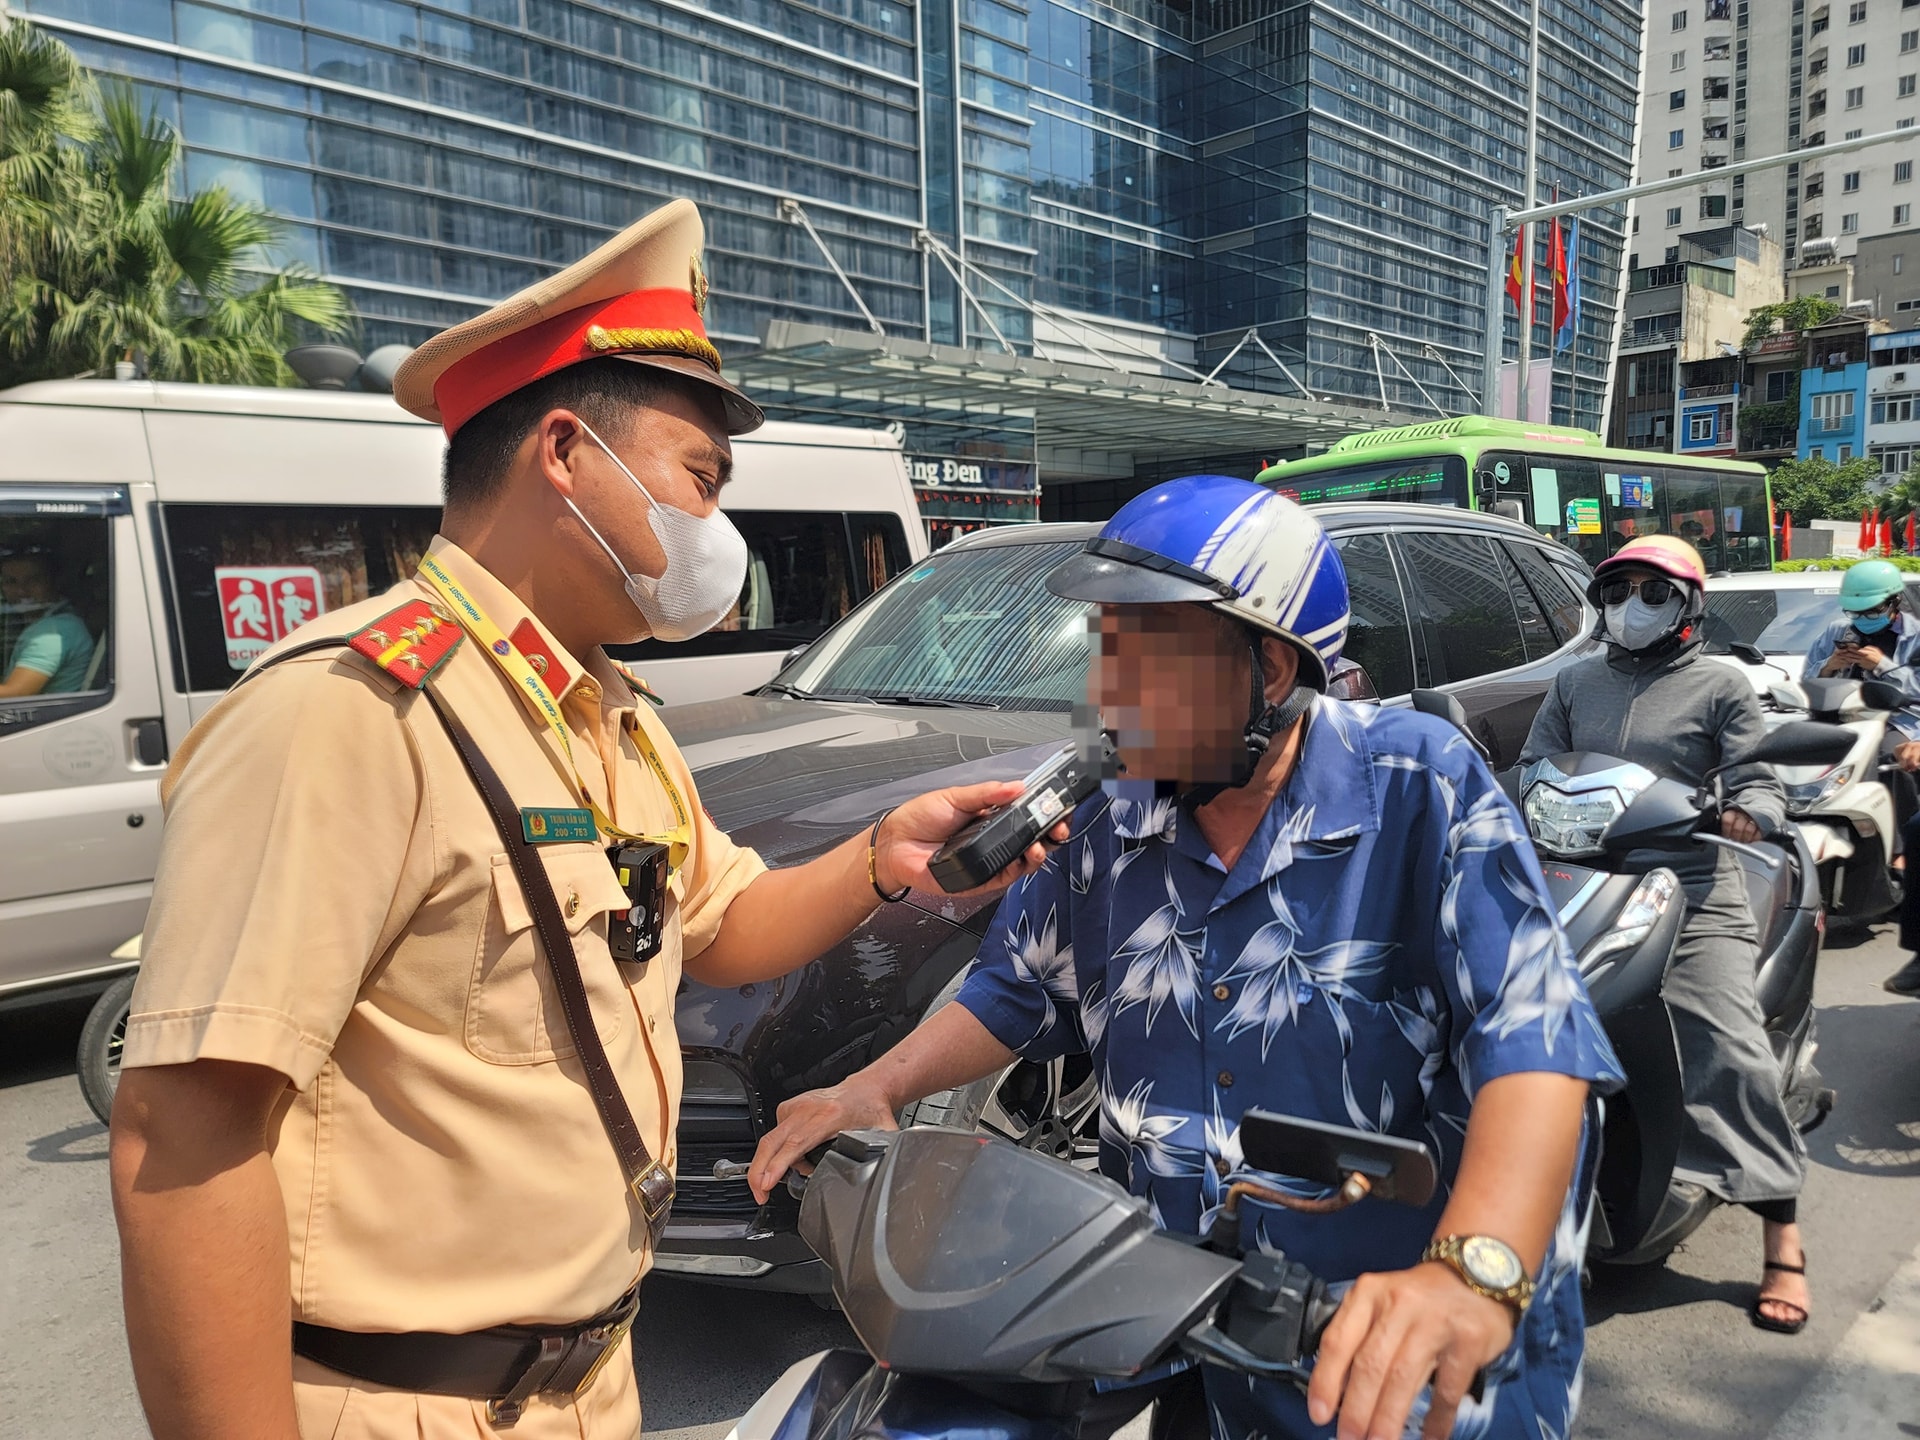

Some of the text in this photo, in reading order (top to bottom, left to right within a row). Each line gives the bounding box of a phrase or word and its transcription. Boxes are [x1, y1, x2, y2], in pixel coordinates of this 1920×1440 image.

[904, 455, 982, 487] ăng Đen
[229, 648, 263, 661] SCH
[525, 676, 538, 689] NỘI
[535, 688, 546, 699] HÀ
[542, 699, 557, 717] CATP
[660, 770, 671, 786] CATP
[670, 789, 679, 805] CSGT
[554, 828, 569, 837] 200
[573, 828, 588, 837] 753
